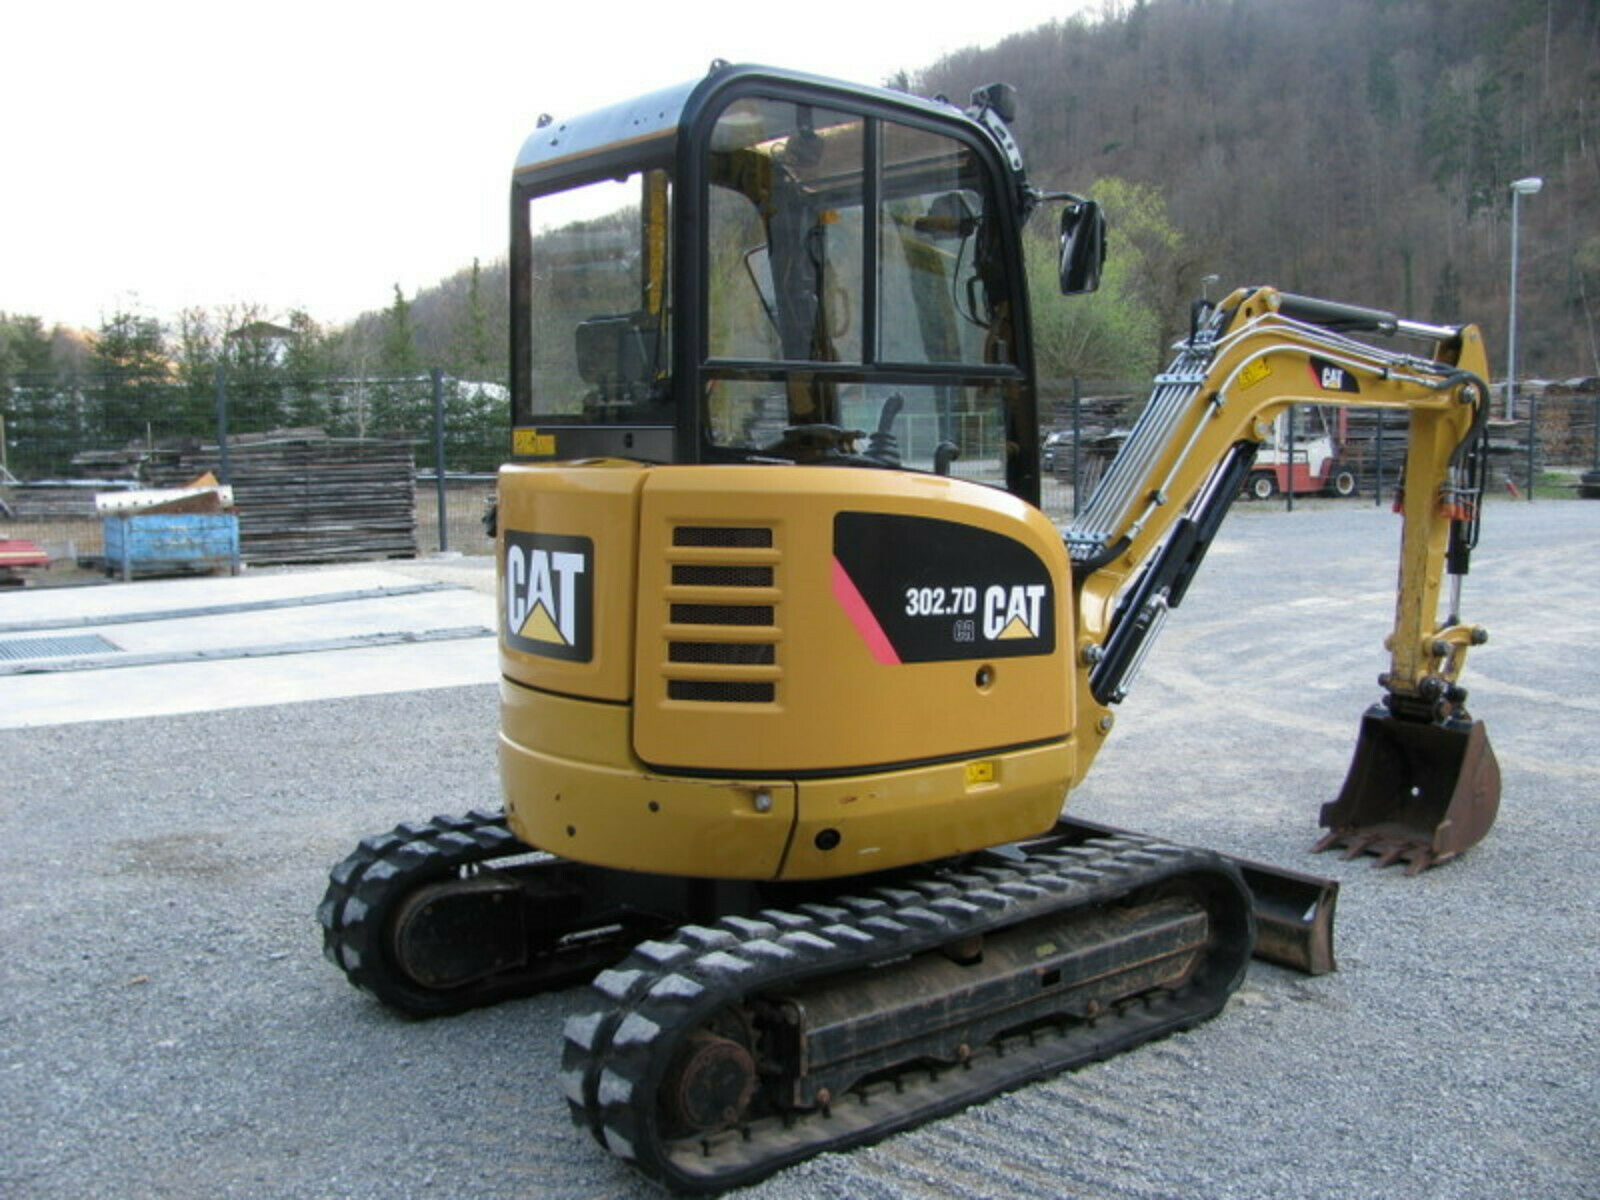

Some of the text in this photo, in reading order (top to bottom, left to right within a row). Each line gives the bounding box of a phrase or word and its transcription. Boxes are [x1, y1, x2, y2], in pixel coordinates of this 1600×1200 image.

[1322, 366, 1343, 389] CAT
[507, 544, 585, 646] CAT
[905, 585, 1046, 640] 302.7D CAT
